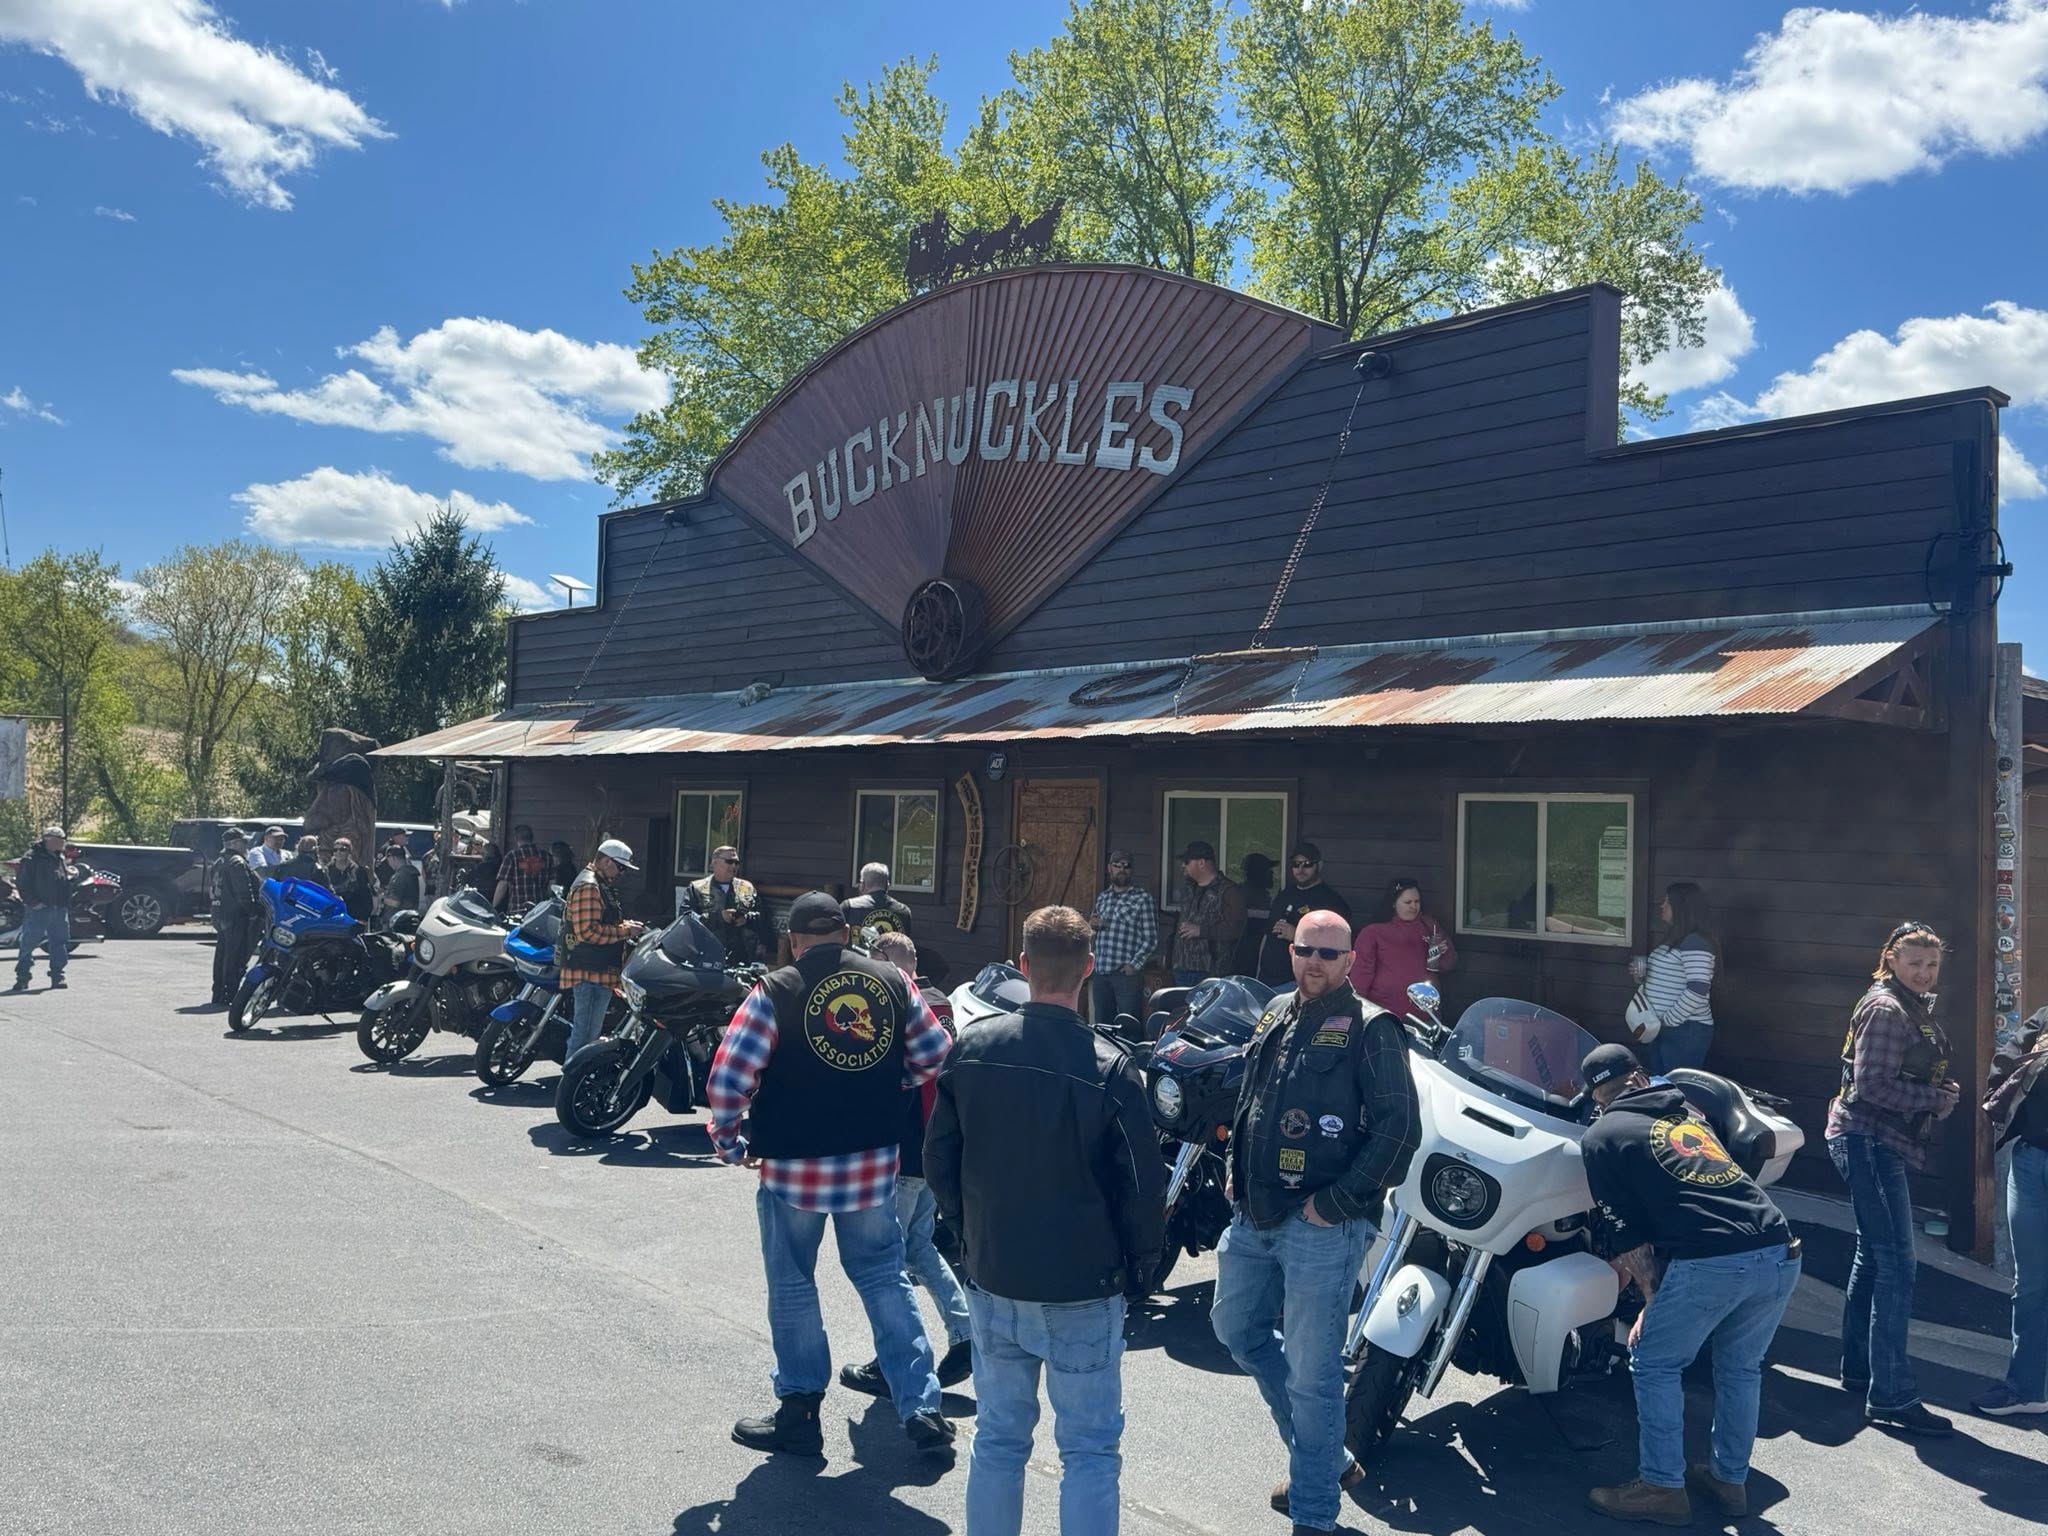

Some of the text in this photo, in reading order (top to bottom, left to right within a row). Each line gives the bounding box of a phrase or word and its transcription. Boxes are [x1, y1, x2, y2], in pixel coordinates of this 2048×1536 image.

[781, 379, 1195, 548] BUCKNUCKLES
[990, 758, 1004, 769] ADT
[907, 852, 921, 865] YES
[808, 975, 888, 1016] COMBAT VETS
[812, 1026, 892, 1067] ASSOCIATION
